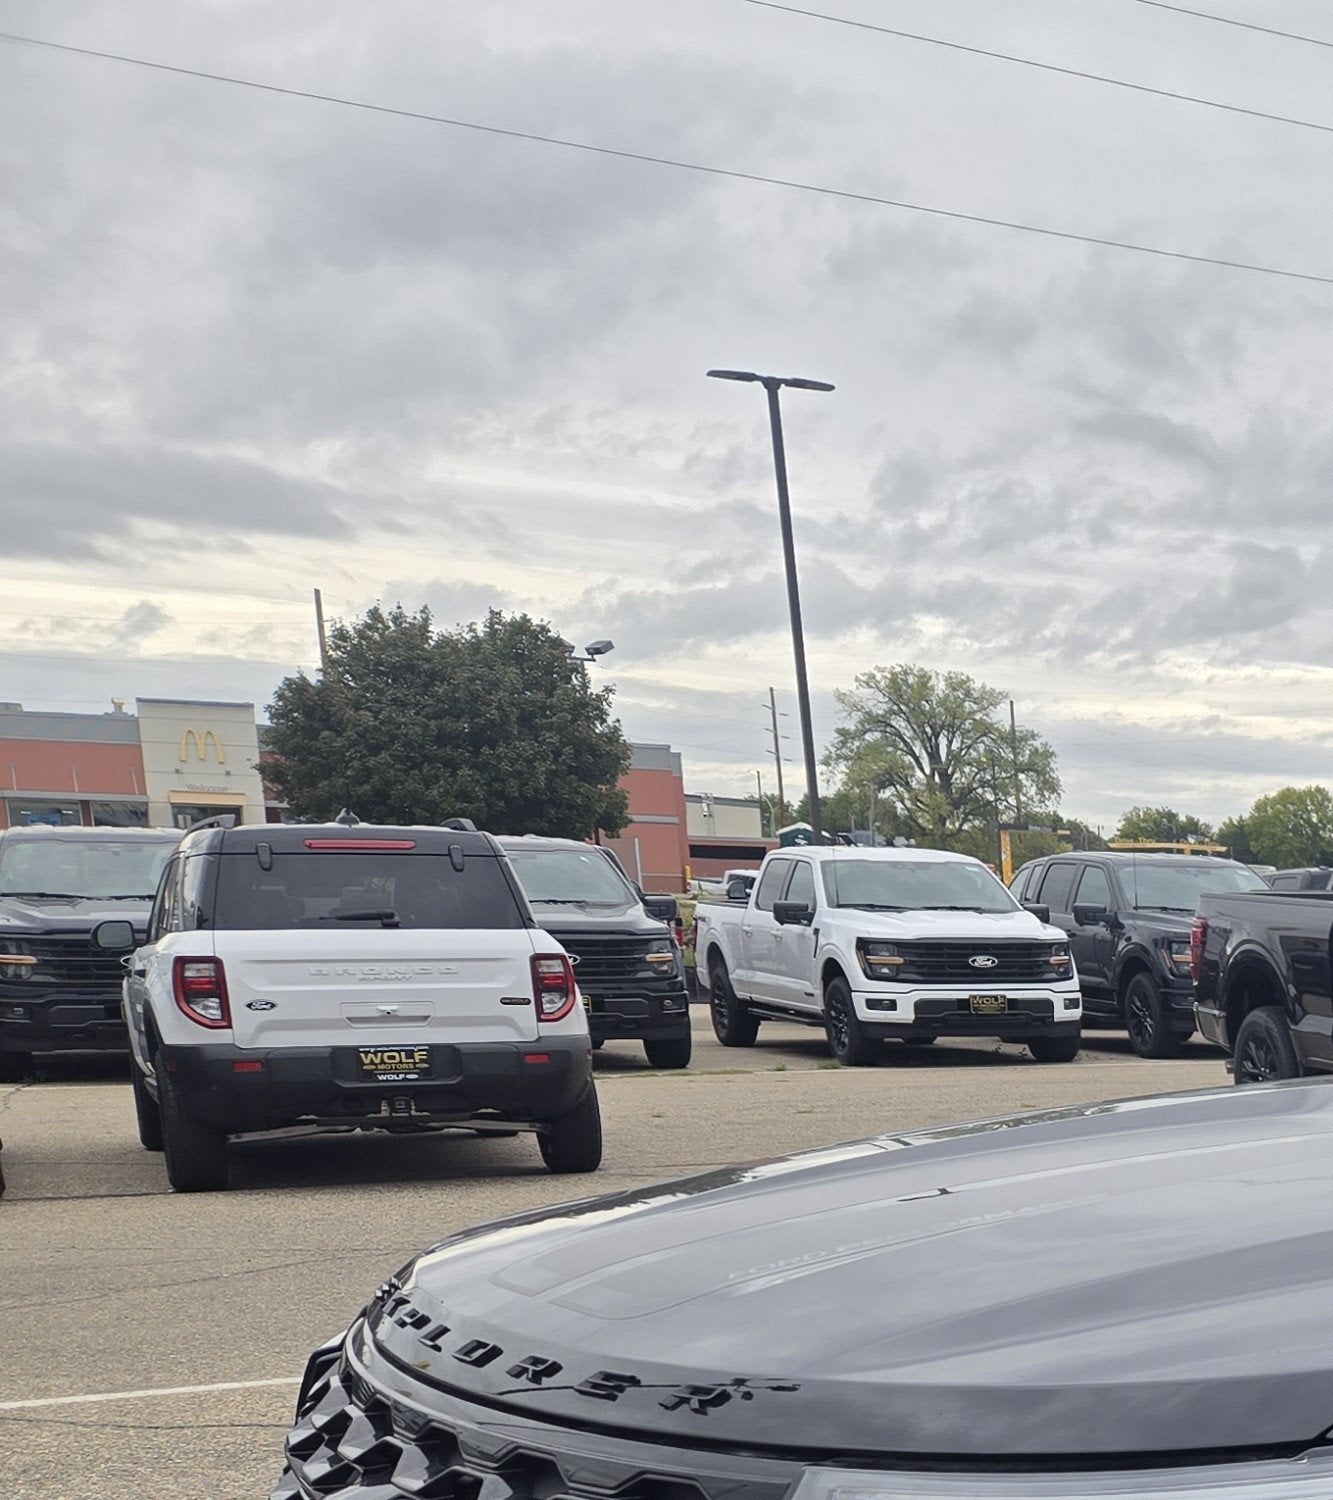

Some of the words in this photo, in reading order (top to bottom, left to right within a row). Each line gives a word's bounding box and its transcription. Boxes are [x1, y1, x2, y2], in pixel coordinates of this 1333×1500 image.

[309, 966, 458, 976] BRONCO
[360, 1051, 428, 1064] WOLF
[374, 1277, 732, 1417] PLORER
